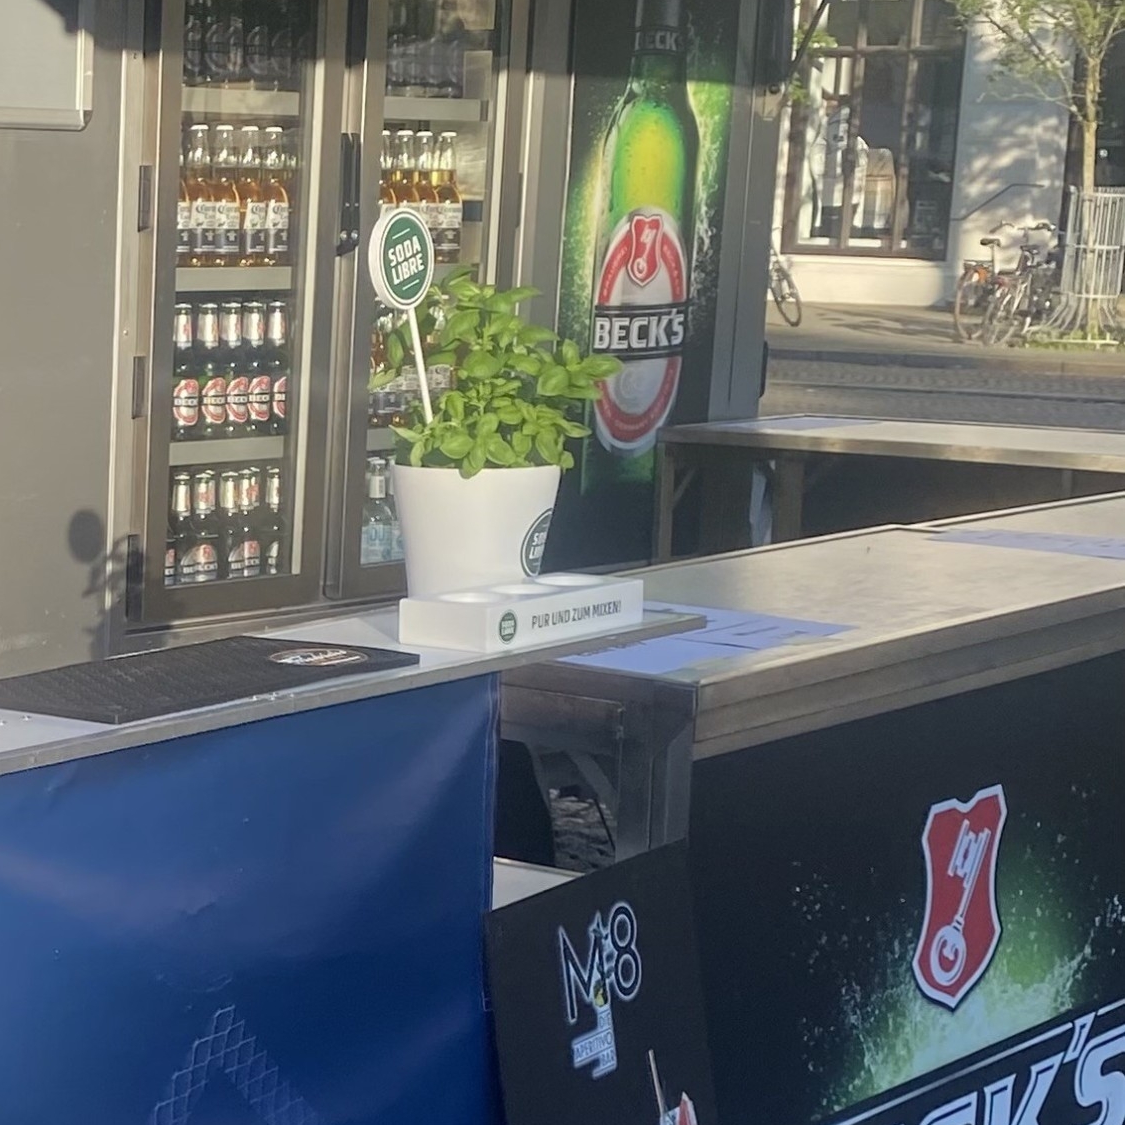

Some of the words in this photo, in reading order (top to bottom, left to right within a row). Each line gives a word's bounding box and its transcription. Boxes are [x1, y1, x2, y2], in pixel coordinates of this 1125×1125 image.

[388, 235, 421, 267] SODA
[392, 253, 425, 285] LIBRE
[593, 308, 685, 350] BECK'S
[531, 613, 550, 629] PUR
[552, 609, 571, 626] UND
[572, 605, 591, 622] ZUM
[592, 599, 622, 619] MIXEN!
[559, 902, 642, 1024] M8
